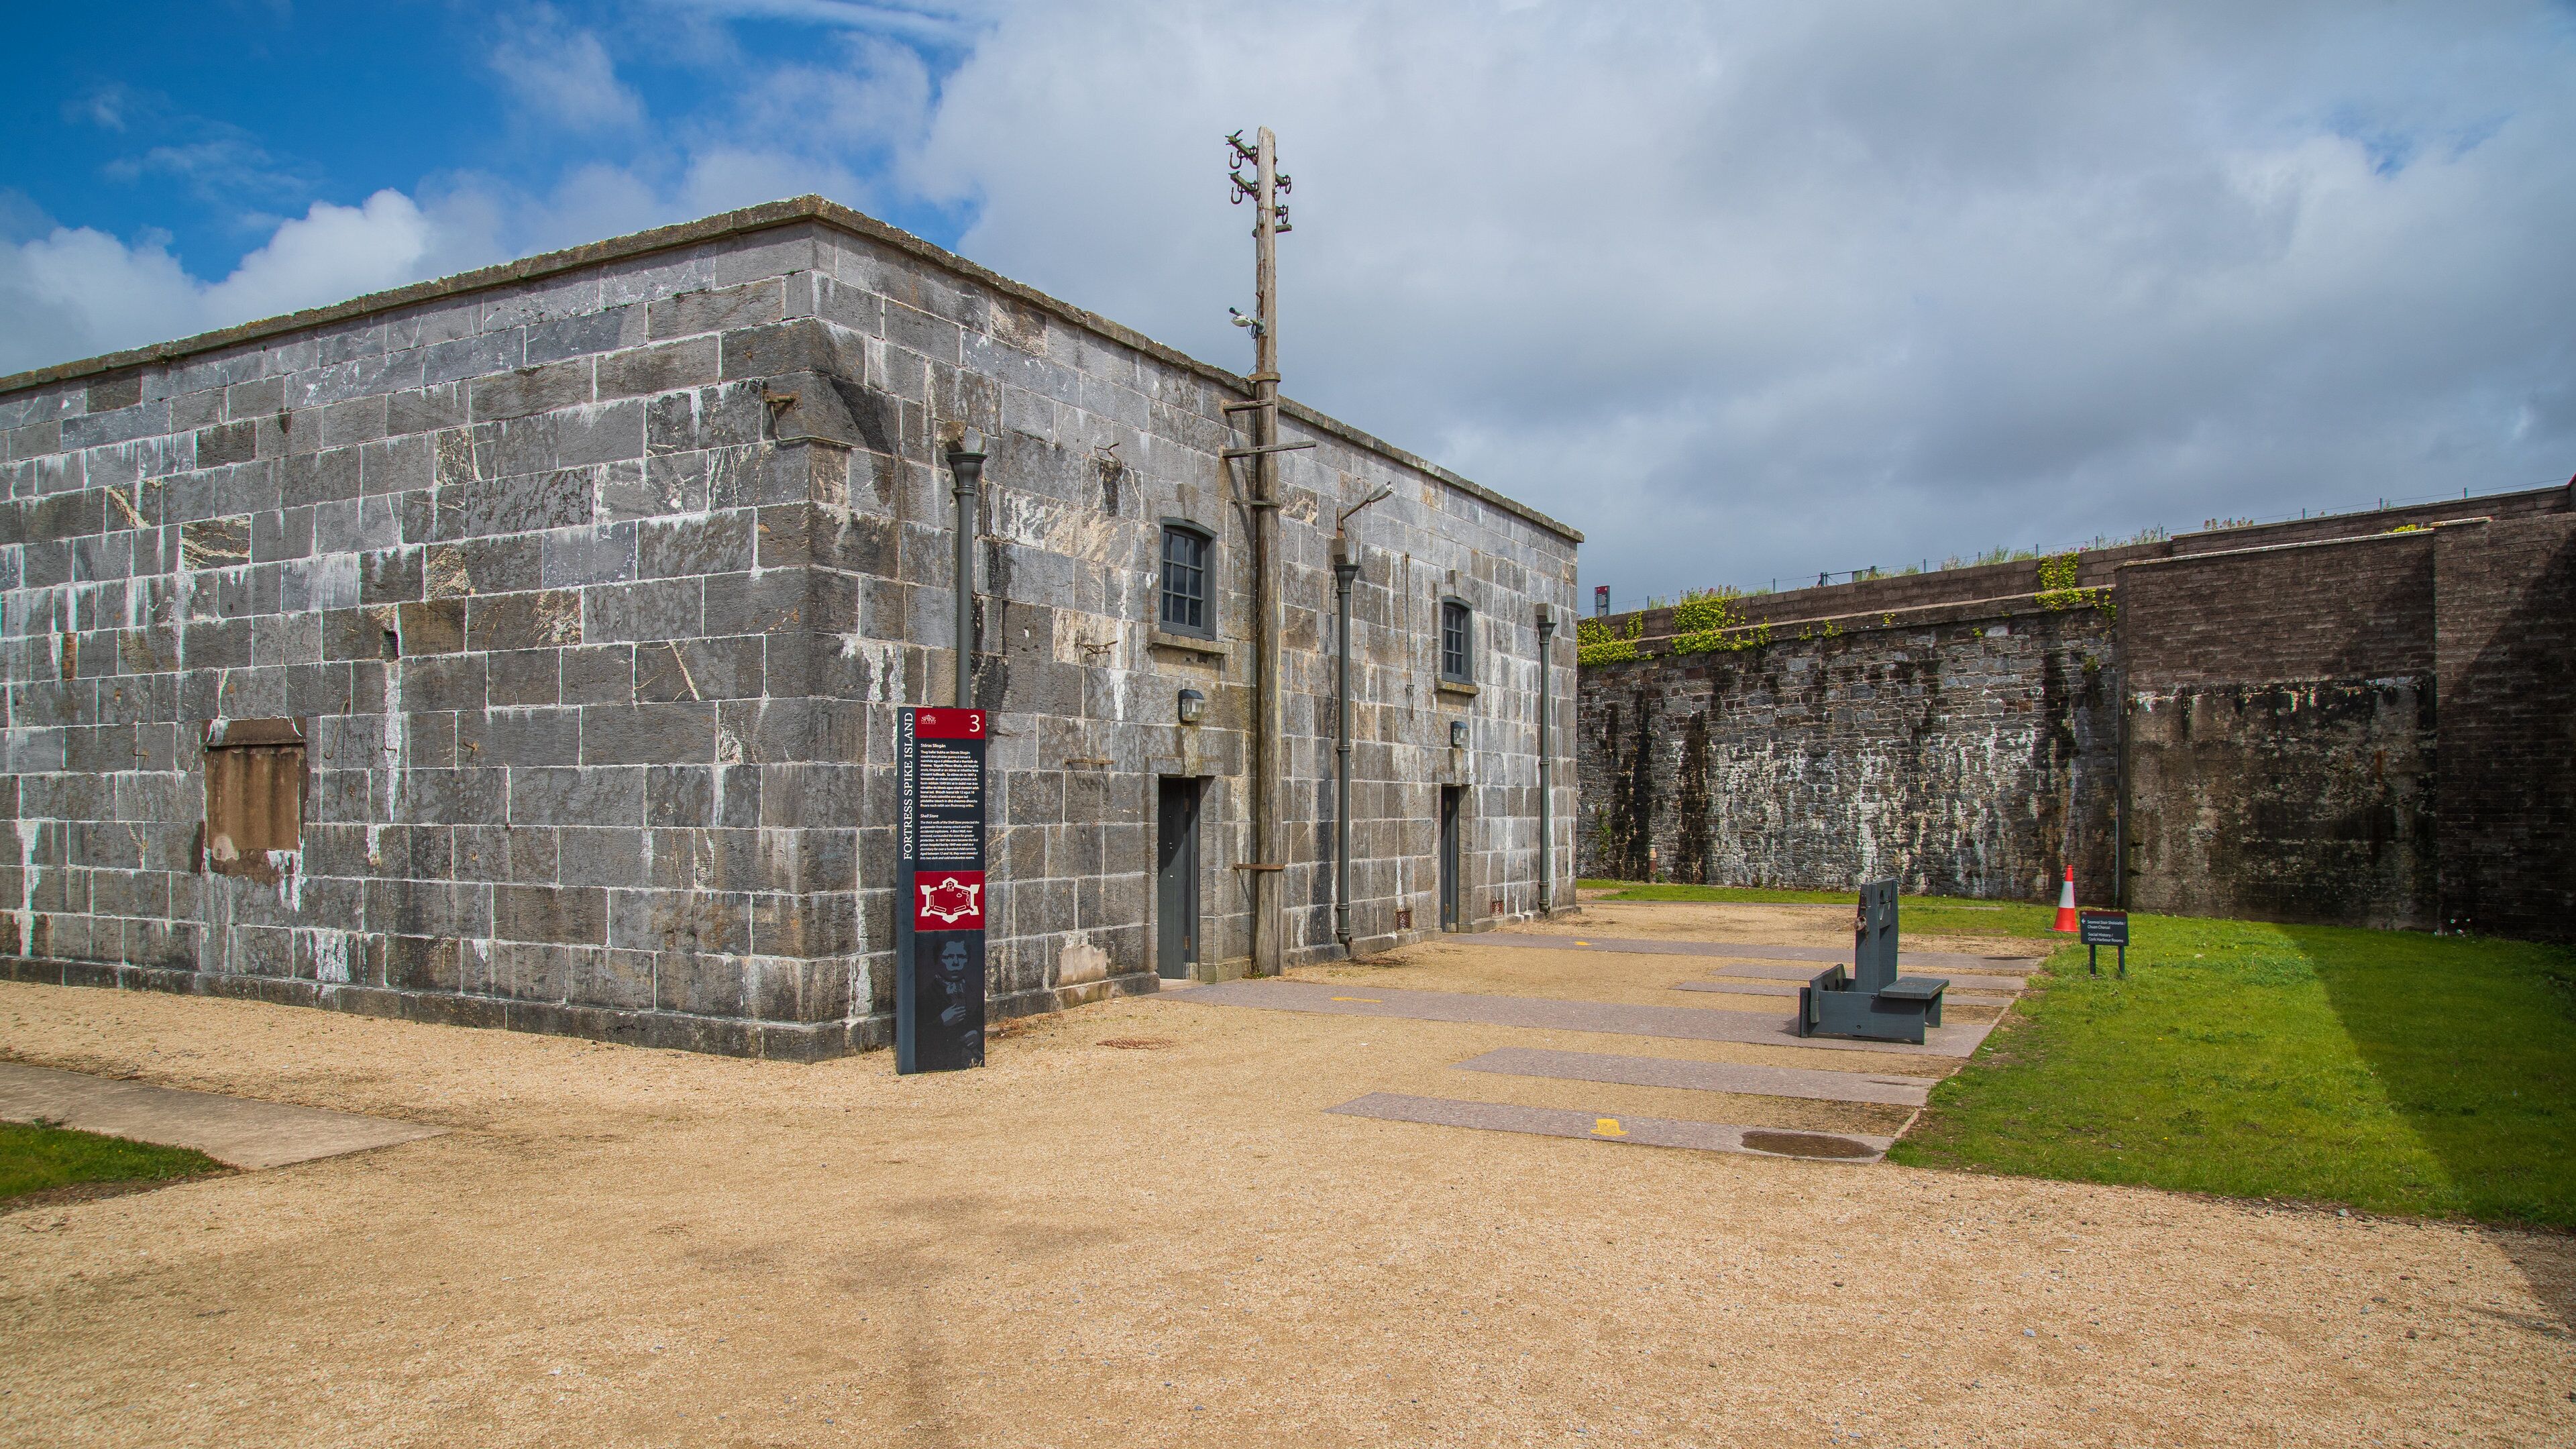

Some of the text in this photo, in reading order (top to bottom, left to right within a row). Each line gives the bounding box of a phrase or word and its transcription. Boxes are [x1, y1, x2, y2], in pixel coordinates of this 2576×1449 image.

[969, 714, 980, 732] 3
[904, 713, 913, 859] FORTRESS SPIKE ISLAND
